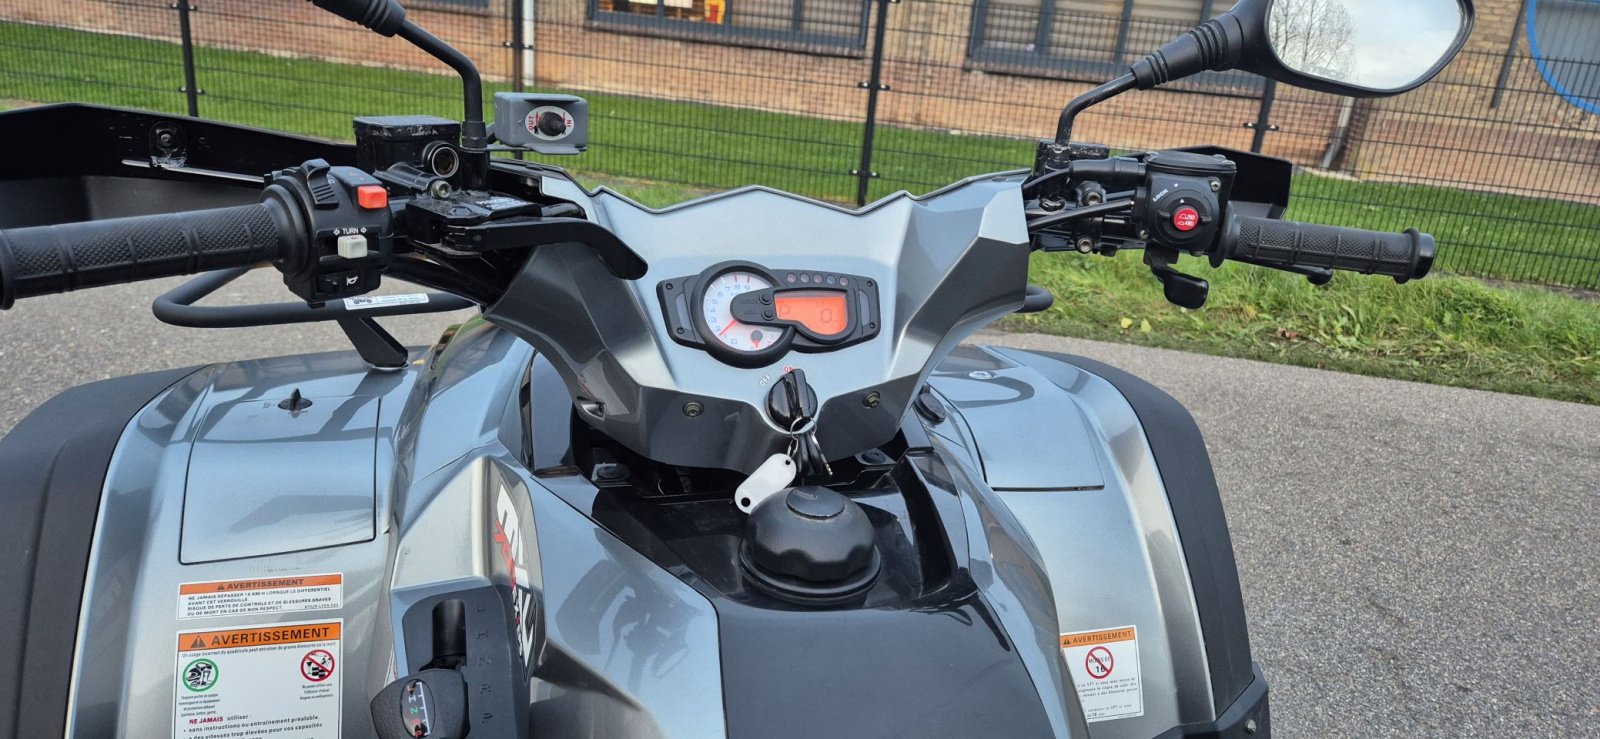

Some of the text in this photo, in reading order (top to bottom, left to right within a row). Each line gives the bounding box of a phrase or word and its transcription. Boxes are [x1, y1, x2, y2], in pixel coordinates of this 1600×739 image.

[1152, 188, 1169, 202] LOCK
[759, 375, 771, 387] OFF
[227, 579, 304, 590] AVERTISSEMENT
[211, 627, 329, 646] AVERTISSEMENT
[1072, 630, 1132, 643] AVERTISSEMENT
[409, 695, 416, 703] H
